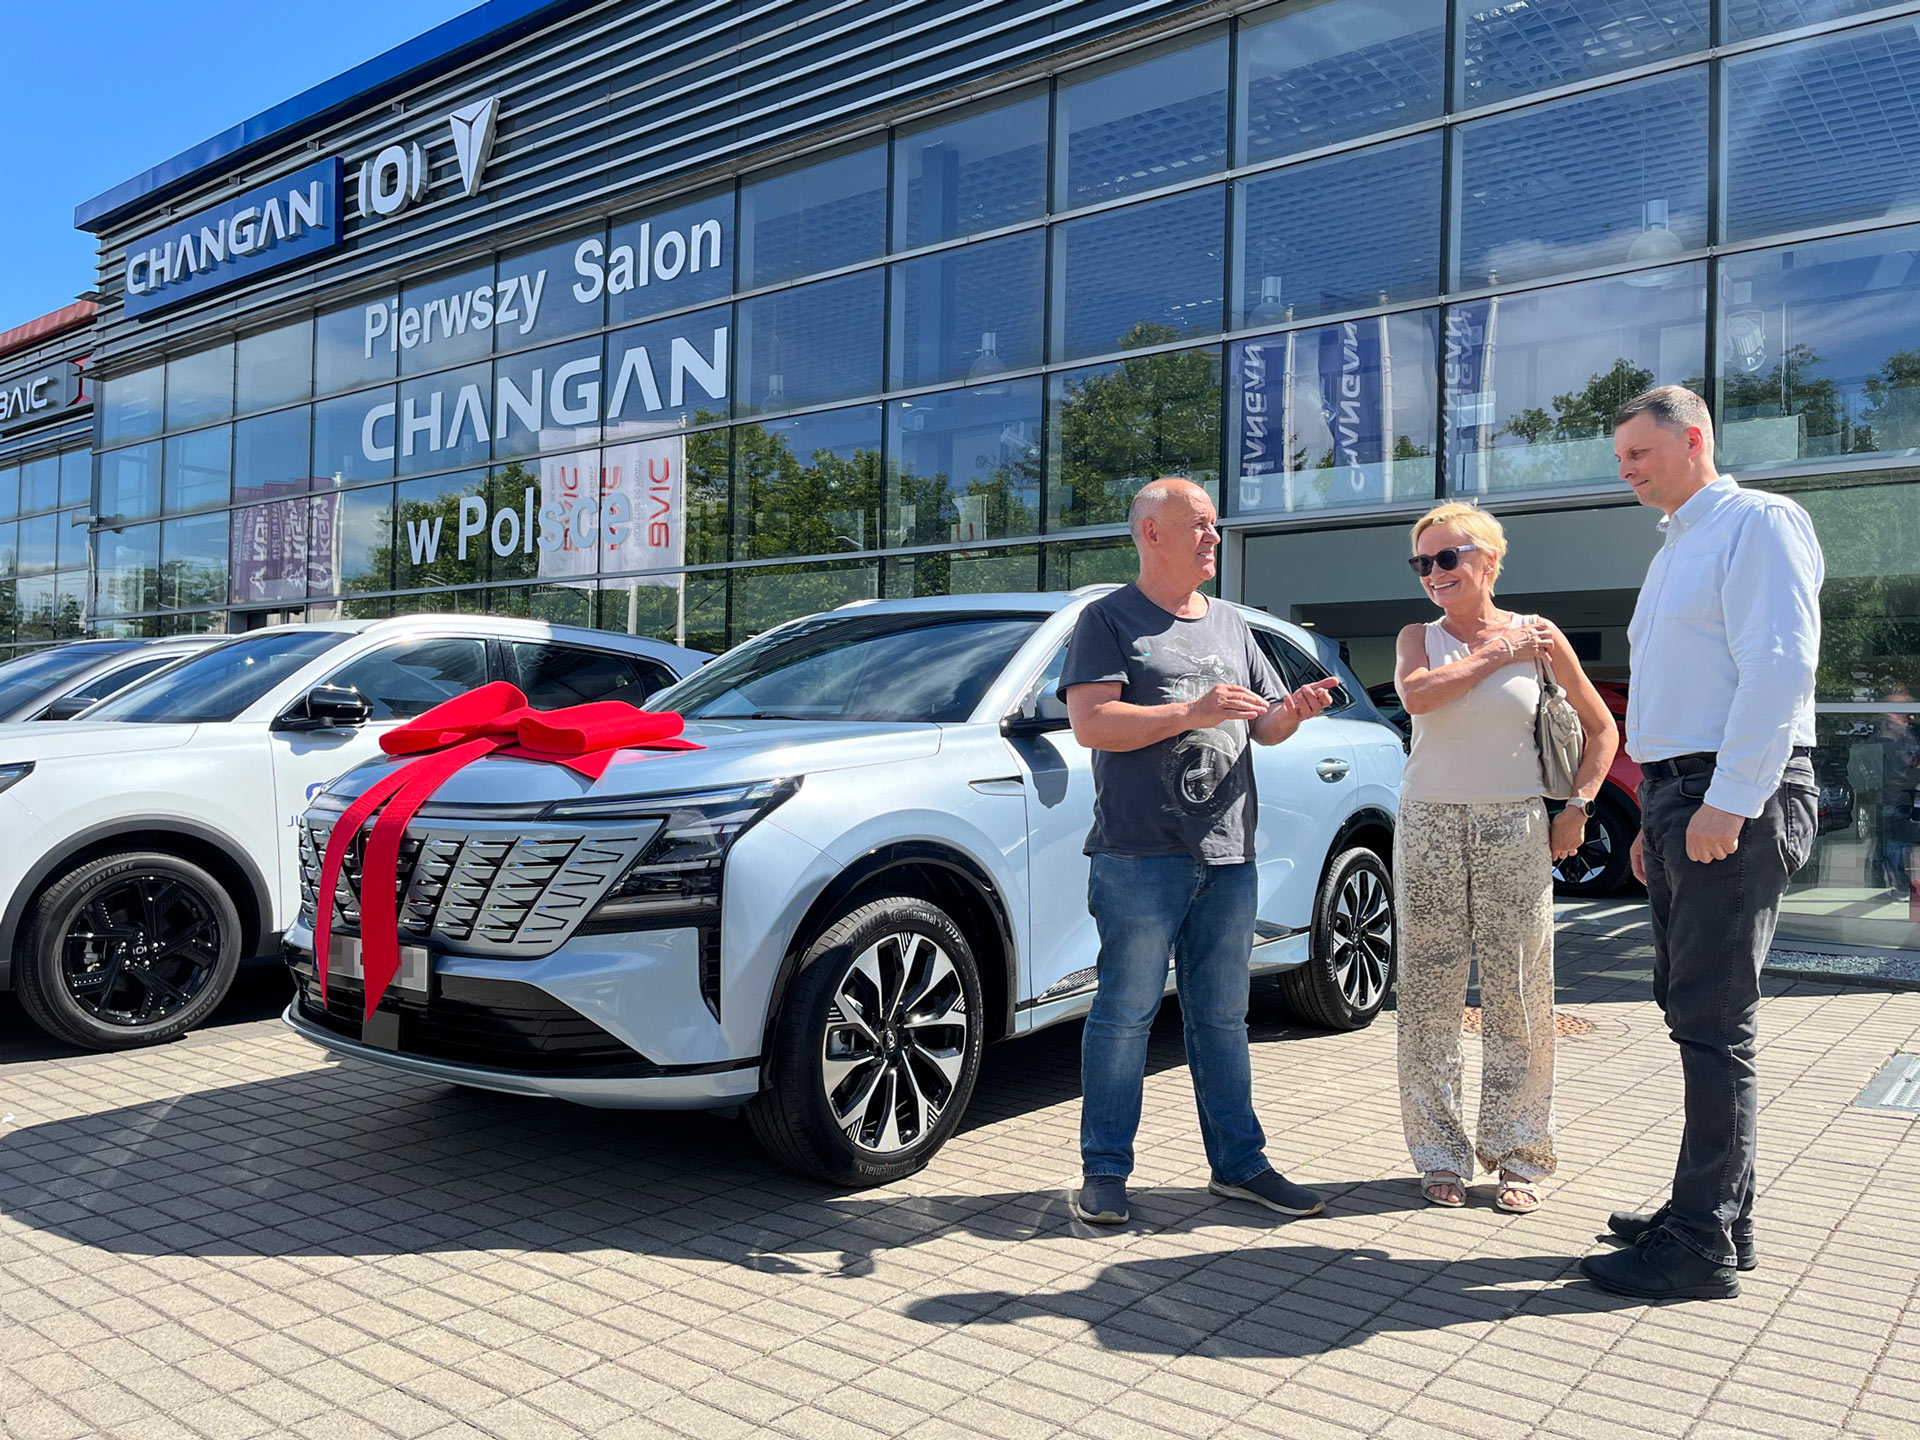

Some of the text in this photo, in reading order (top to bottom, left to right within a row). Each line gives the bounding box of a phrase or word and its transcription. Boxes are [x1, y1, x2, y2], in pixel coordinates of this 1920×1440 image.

[127, 180, 323, 295] CHANGAN
[364, 219, 721, 359] Pierwszy Salon
[361, 326, 728, 462] CHANGAN
[407, 517, 443, 565] w
[458, 487, 632, 560] Polsce
[893, 908, 937, 925] Continental
